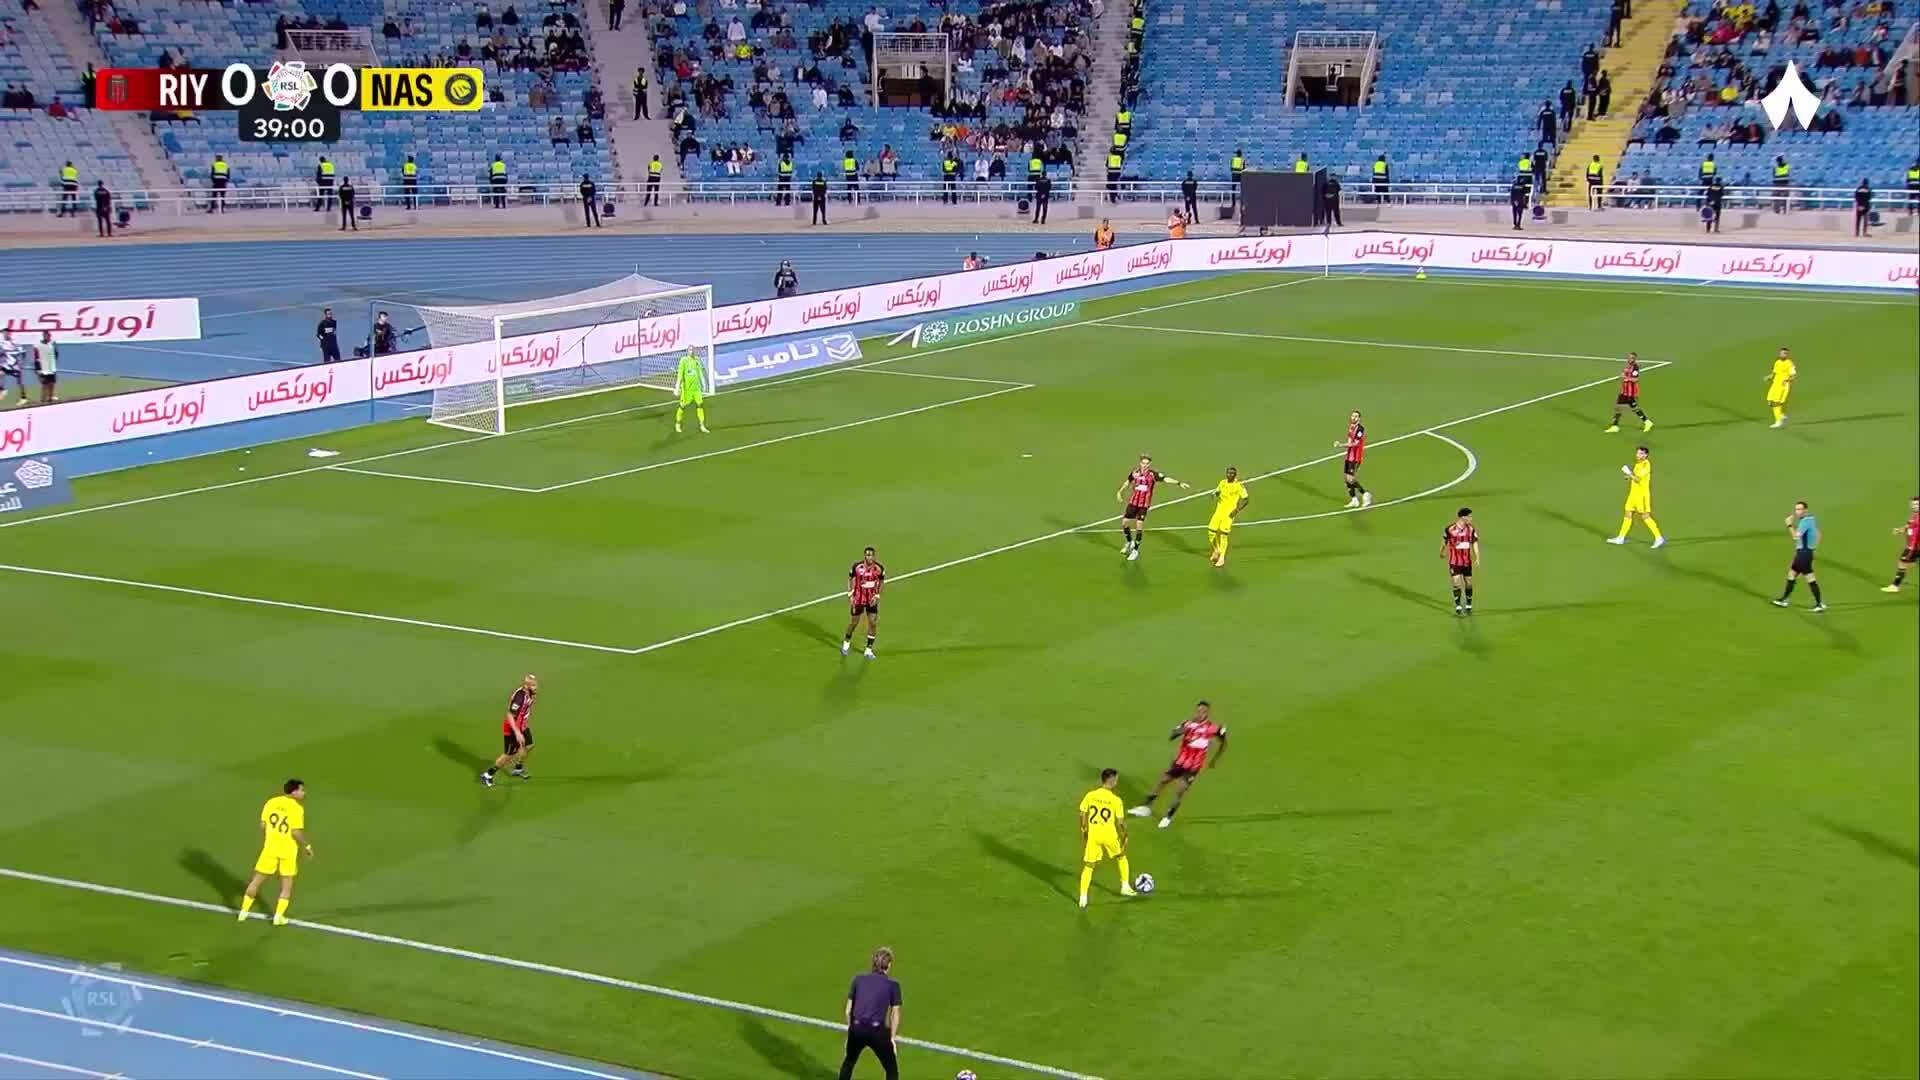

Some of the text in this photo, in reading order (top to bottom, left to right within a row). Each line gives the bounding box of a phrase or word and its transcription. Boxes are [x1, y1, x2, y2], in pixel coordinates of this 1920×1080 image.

[1210, 239, 1293, 264] أورينكس
[953, 303, 1075, 336] ROSHN GROUP
[248, 369, 334, 411] أورينكس
[112, 387, 206, 433] أورينكس
[269, 813, 289, 834] 96
[1089, 805, 1111, 825] 29
